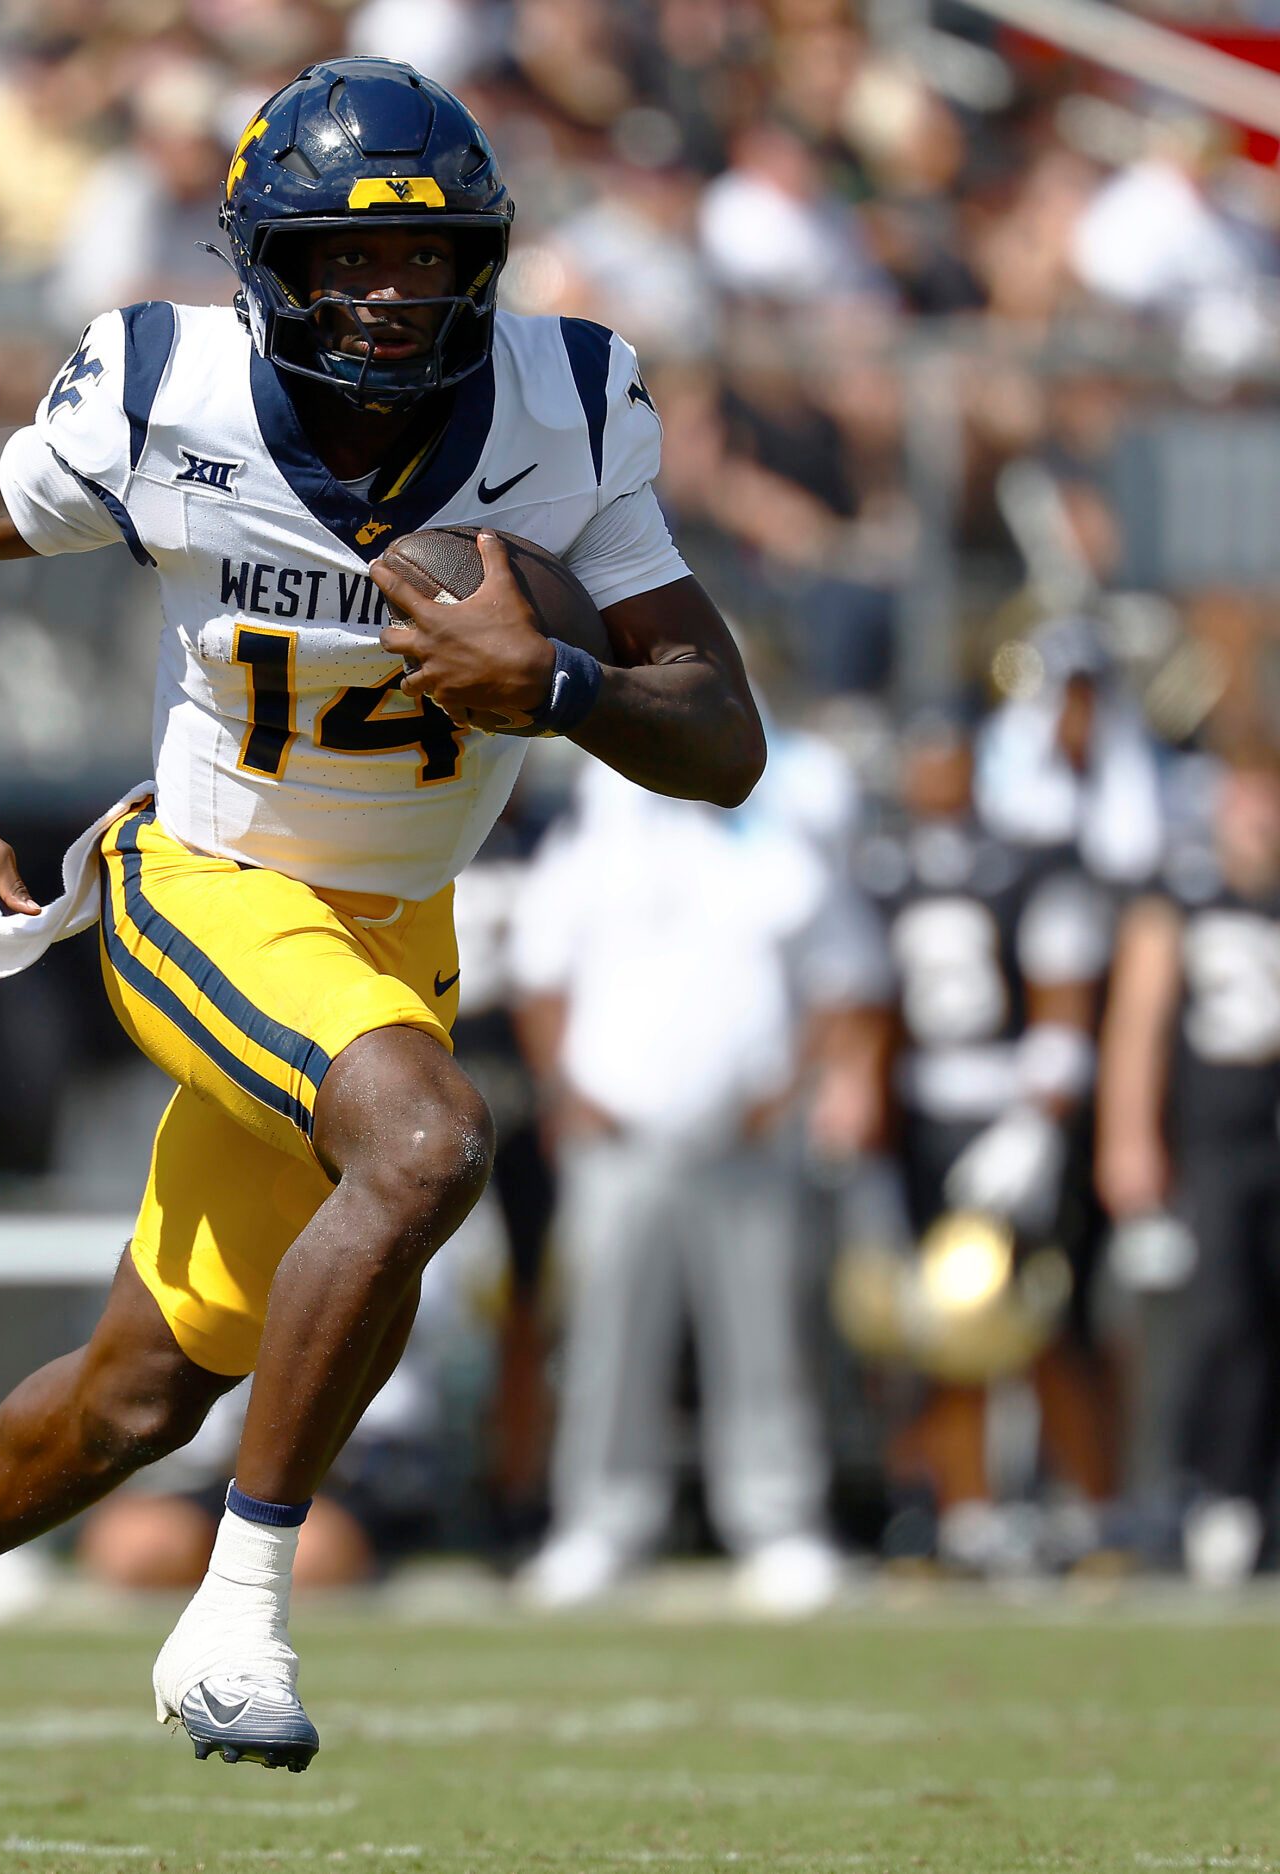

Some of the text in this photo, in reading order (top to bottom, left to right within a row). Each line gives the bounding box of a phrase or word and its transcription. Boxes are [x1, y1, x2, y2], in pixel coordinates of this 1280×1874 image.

[173, 447, 243, 497] XII
[219, 557, 328, 621] WEST
[230, 622, 472, 789] 14
